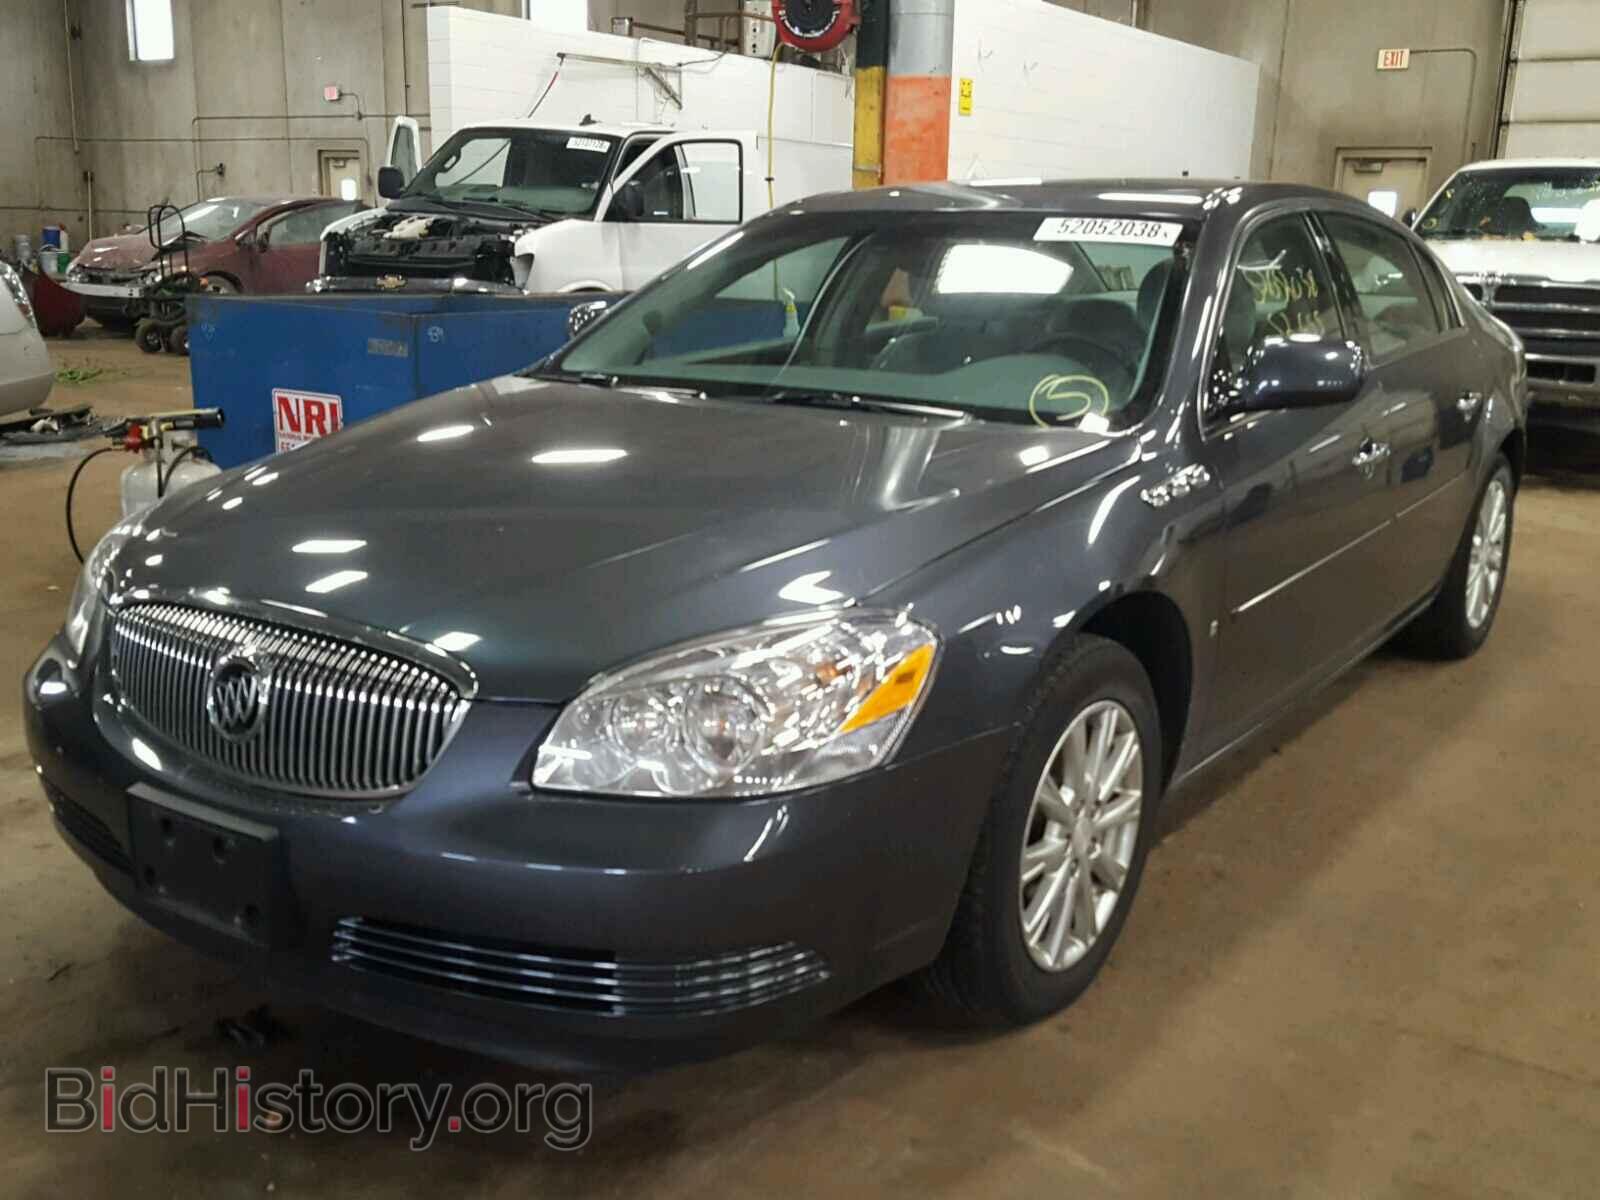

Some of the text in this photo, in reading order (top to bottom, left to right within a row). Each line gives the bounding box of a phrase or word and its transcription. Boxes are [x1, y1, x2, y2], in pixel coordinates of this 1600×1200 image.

[1383, 51, 1404, 66] EXIT
[1056, 217, 1162, 239] 52052038
[277, 395, 339, 436] NRI
